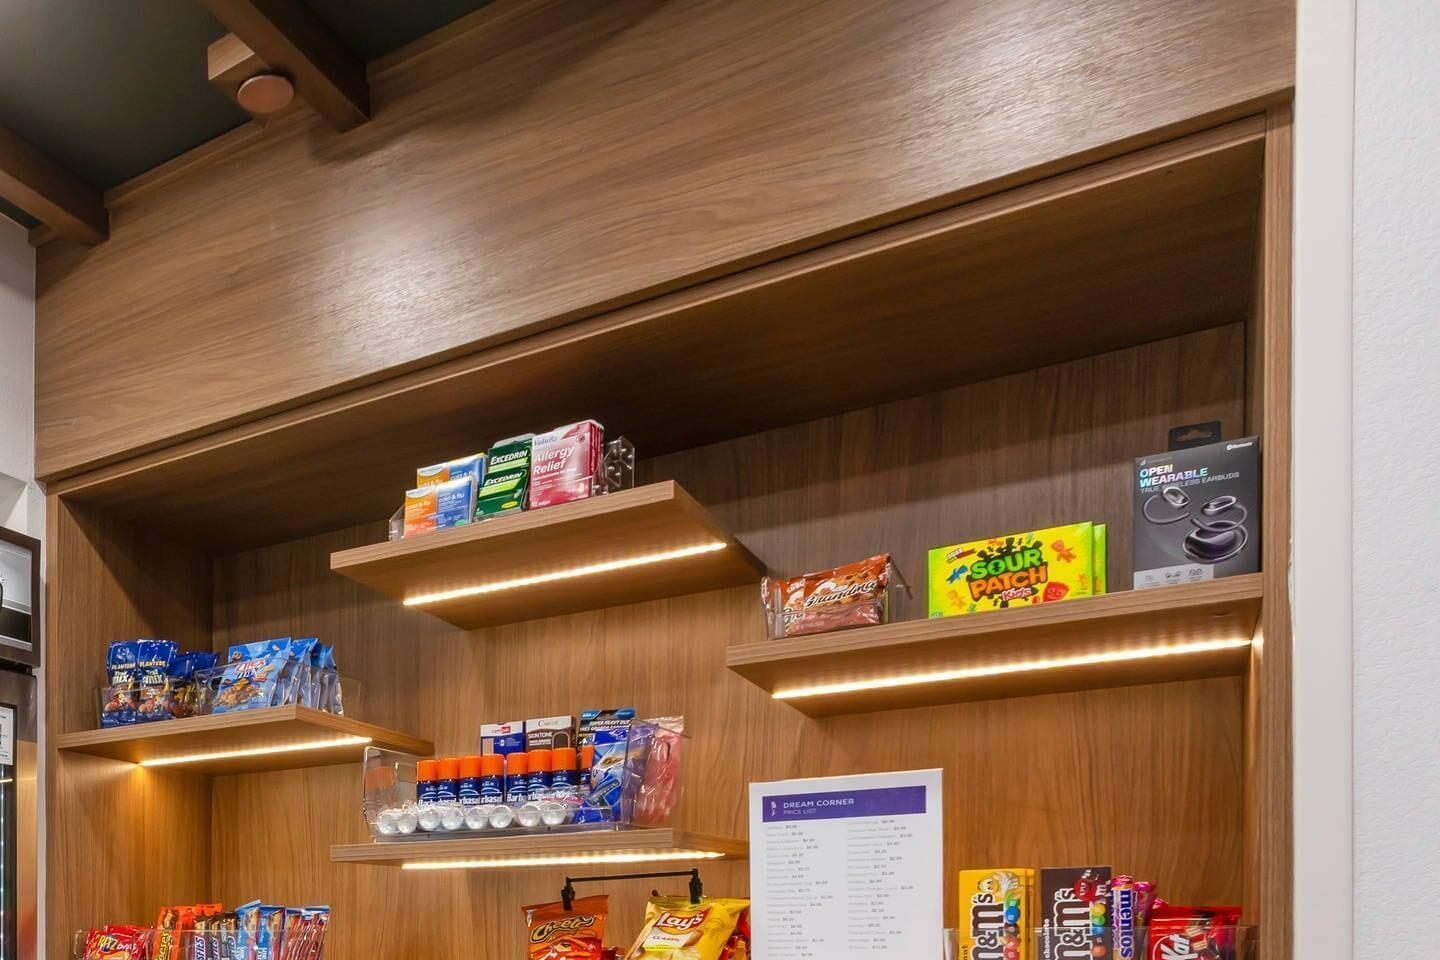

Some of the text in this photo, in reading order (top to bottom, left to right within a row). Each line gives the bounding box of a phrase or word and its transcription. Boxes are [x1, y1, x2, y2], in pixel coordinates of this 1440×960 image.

[490, 449, 528, 465] EXCEDRIN
[534, 446, 575, 462] Allergy
[533, 458, 566, 475] Relief
[1139, 464, 1173, 478] OPEN
[484, 471, 522, 486] EXCEDRIN
[1139, 467, 1209, 488] WEARABLE
[1163, 478, 1201, 488] WIRELESS
[1202, 472, 1239, 482] EARBUDS
[971, 549, 1042, 580] SOUR
[968, 563, 1048, 599] PATCH
[783, 798, 855, 809] DREAM CORNER
[657, 911, 704, 931] Lay's
[1119, 890, 1133, 959] mentos
